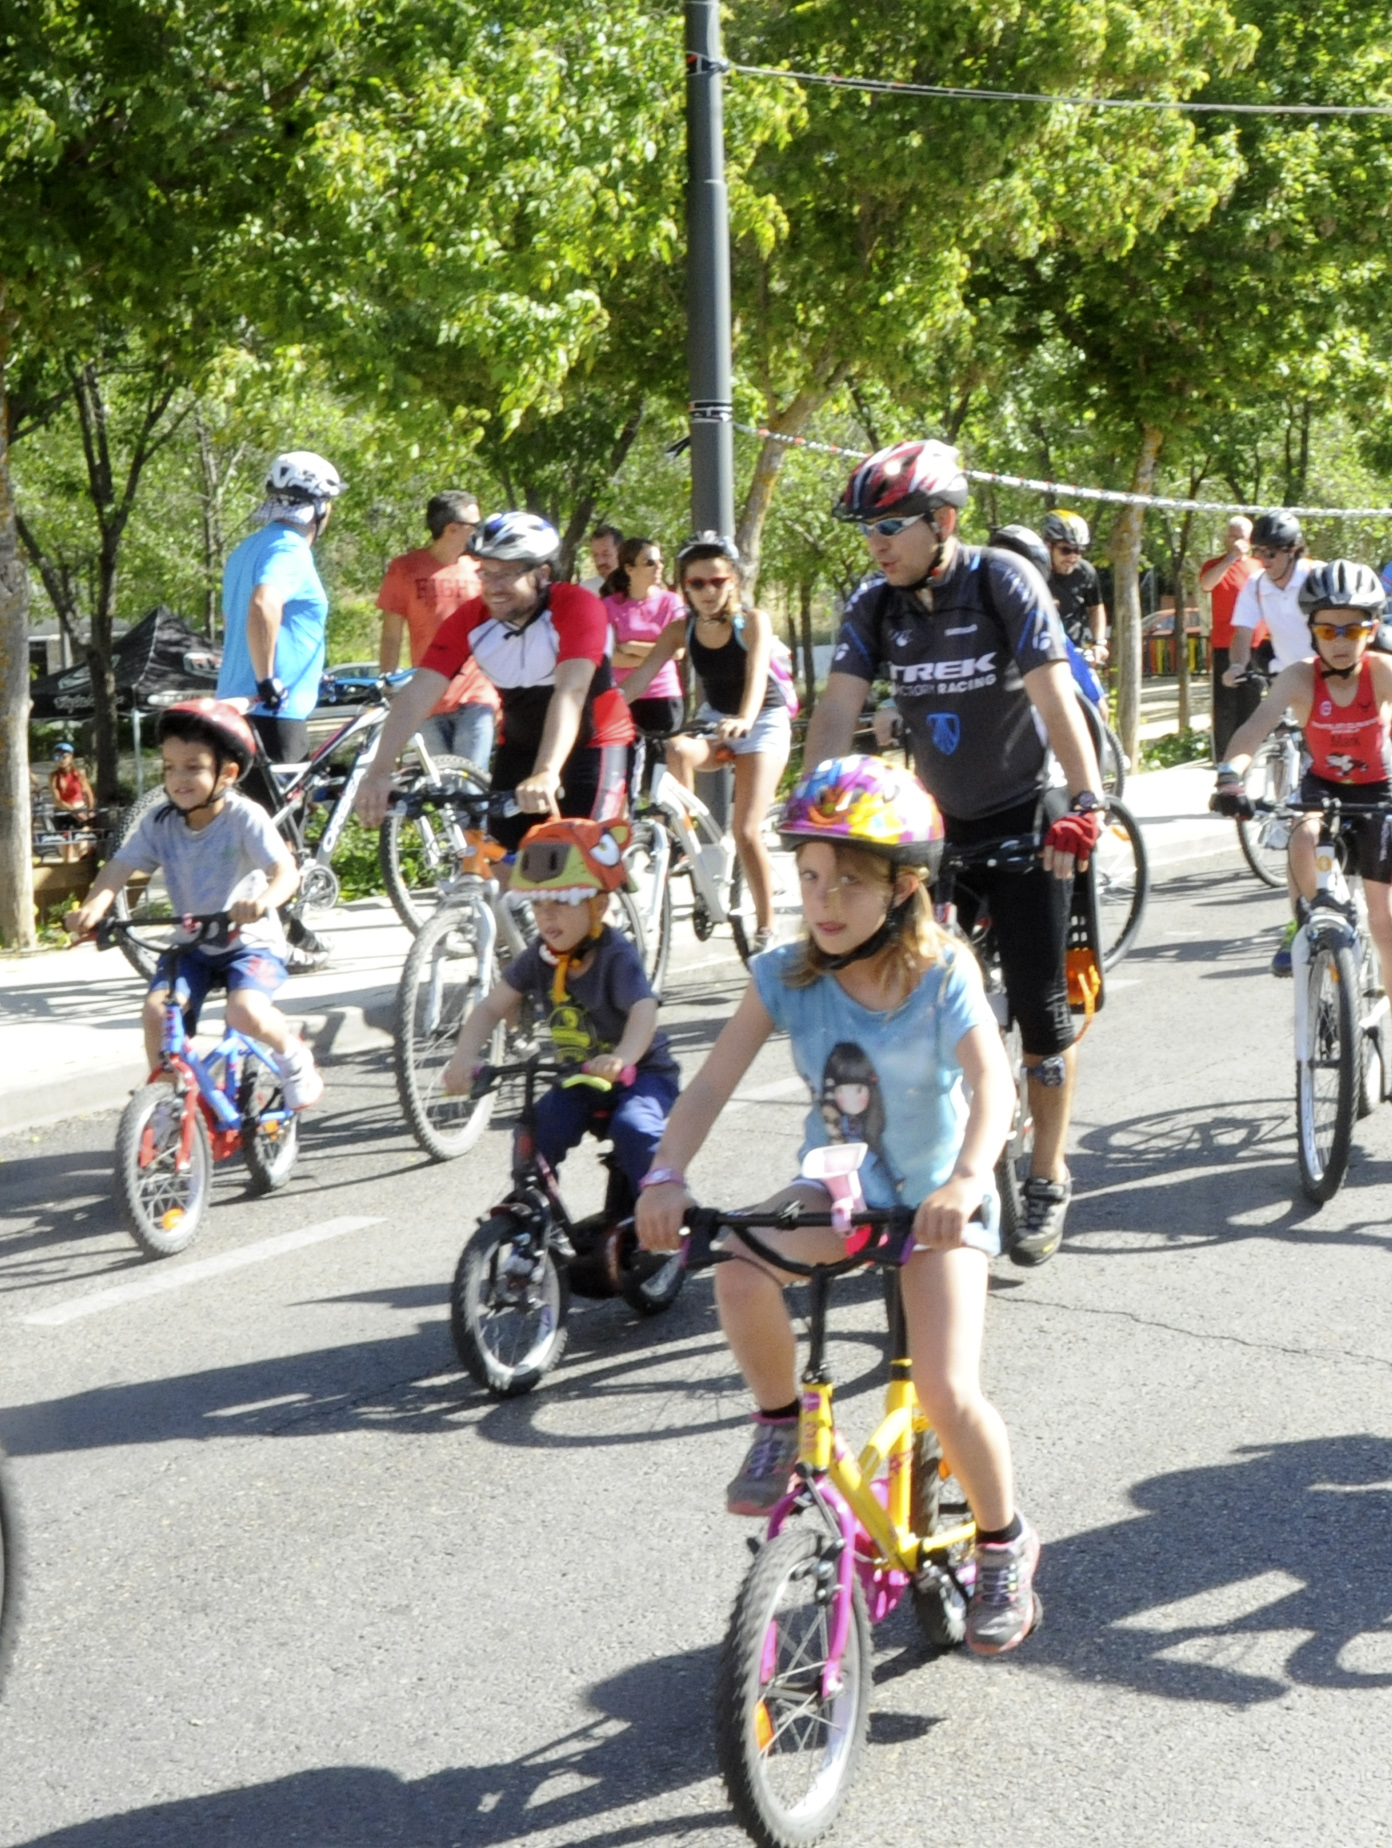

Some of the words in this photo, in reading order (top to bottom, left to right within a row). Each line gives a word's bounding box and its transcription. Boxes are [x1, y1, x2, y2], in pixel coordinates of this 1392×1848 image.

[888, 652, 998, 683] TREK
[937, 674, 997, 694] RACING
[323, 768, 367, 853] ORBEA
